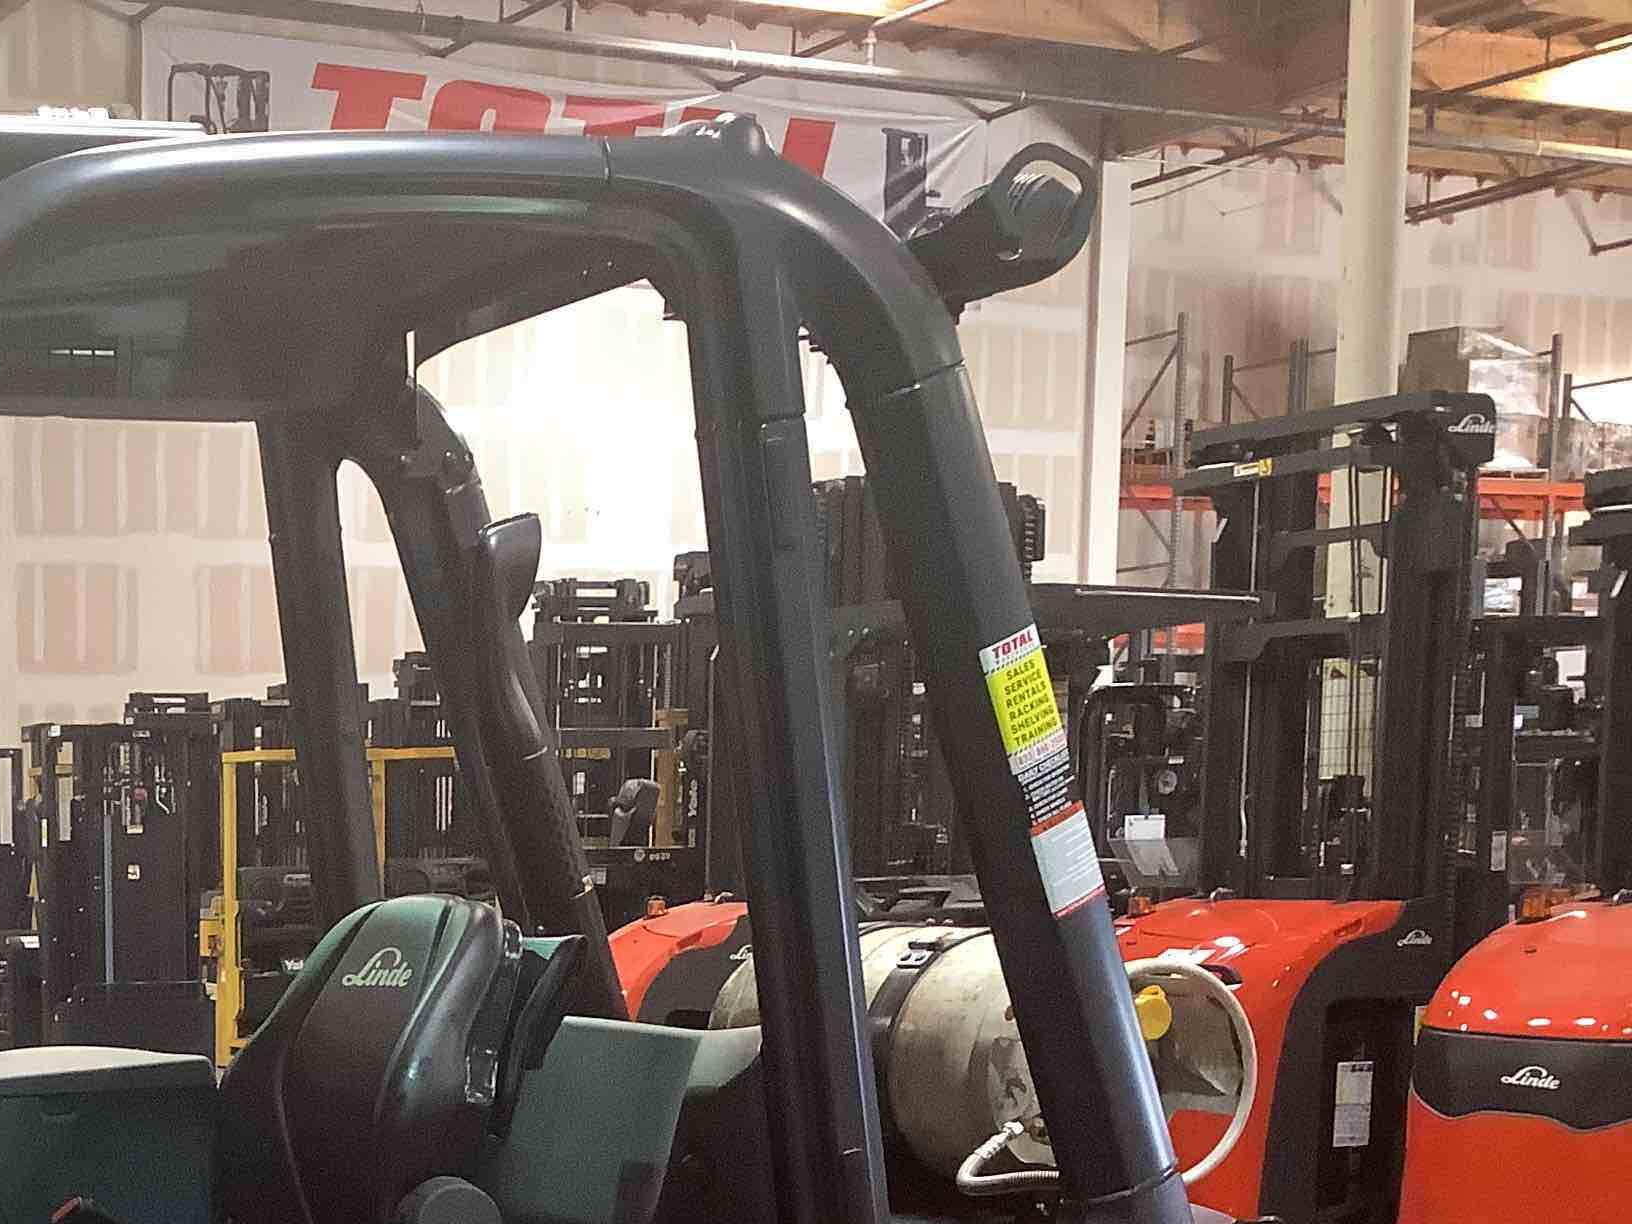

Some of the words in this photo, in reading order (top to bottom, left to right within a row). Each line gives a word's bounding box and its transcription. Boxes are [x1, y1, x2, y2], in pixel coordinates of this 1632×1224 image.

[311, 62, 835, 182] TOTL
[992, 631, 1033, 659] TOTAL
[1004, 669, 1042, 695] SERVICE
[1006, 659, 1035, 681] SALES
[1006, 681, 1047, 709] RENTALS
[1009, 694, 1050, 721] RACKING
[1010, 704, 1055, 735] SHELVING
[1015, 718, 1058, 747] TRAINING
[284, 959, 304, 971] Yal
[342, 947, 413, 987] Linde
[1500, 1065, 1561, 1090] Linde
